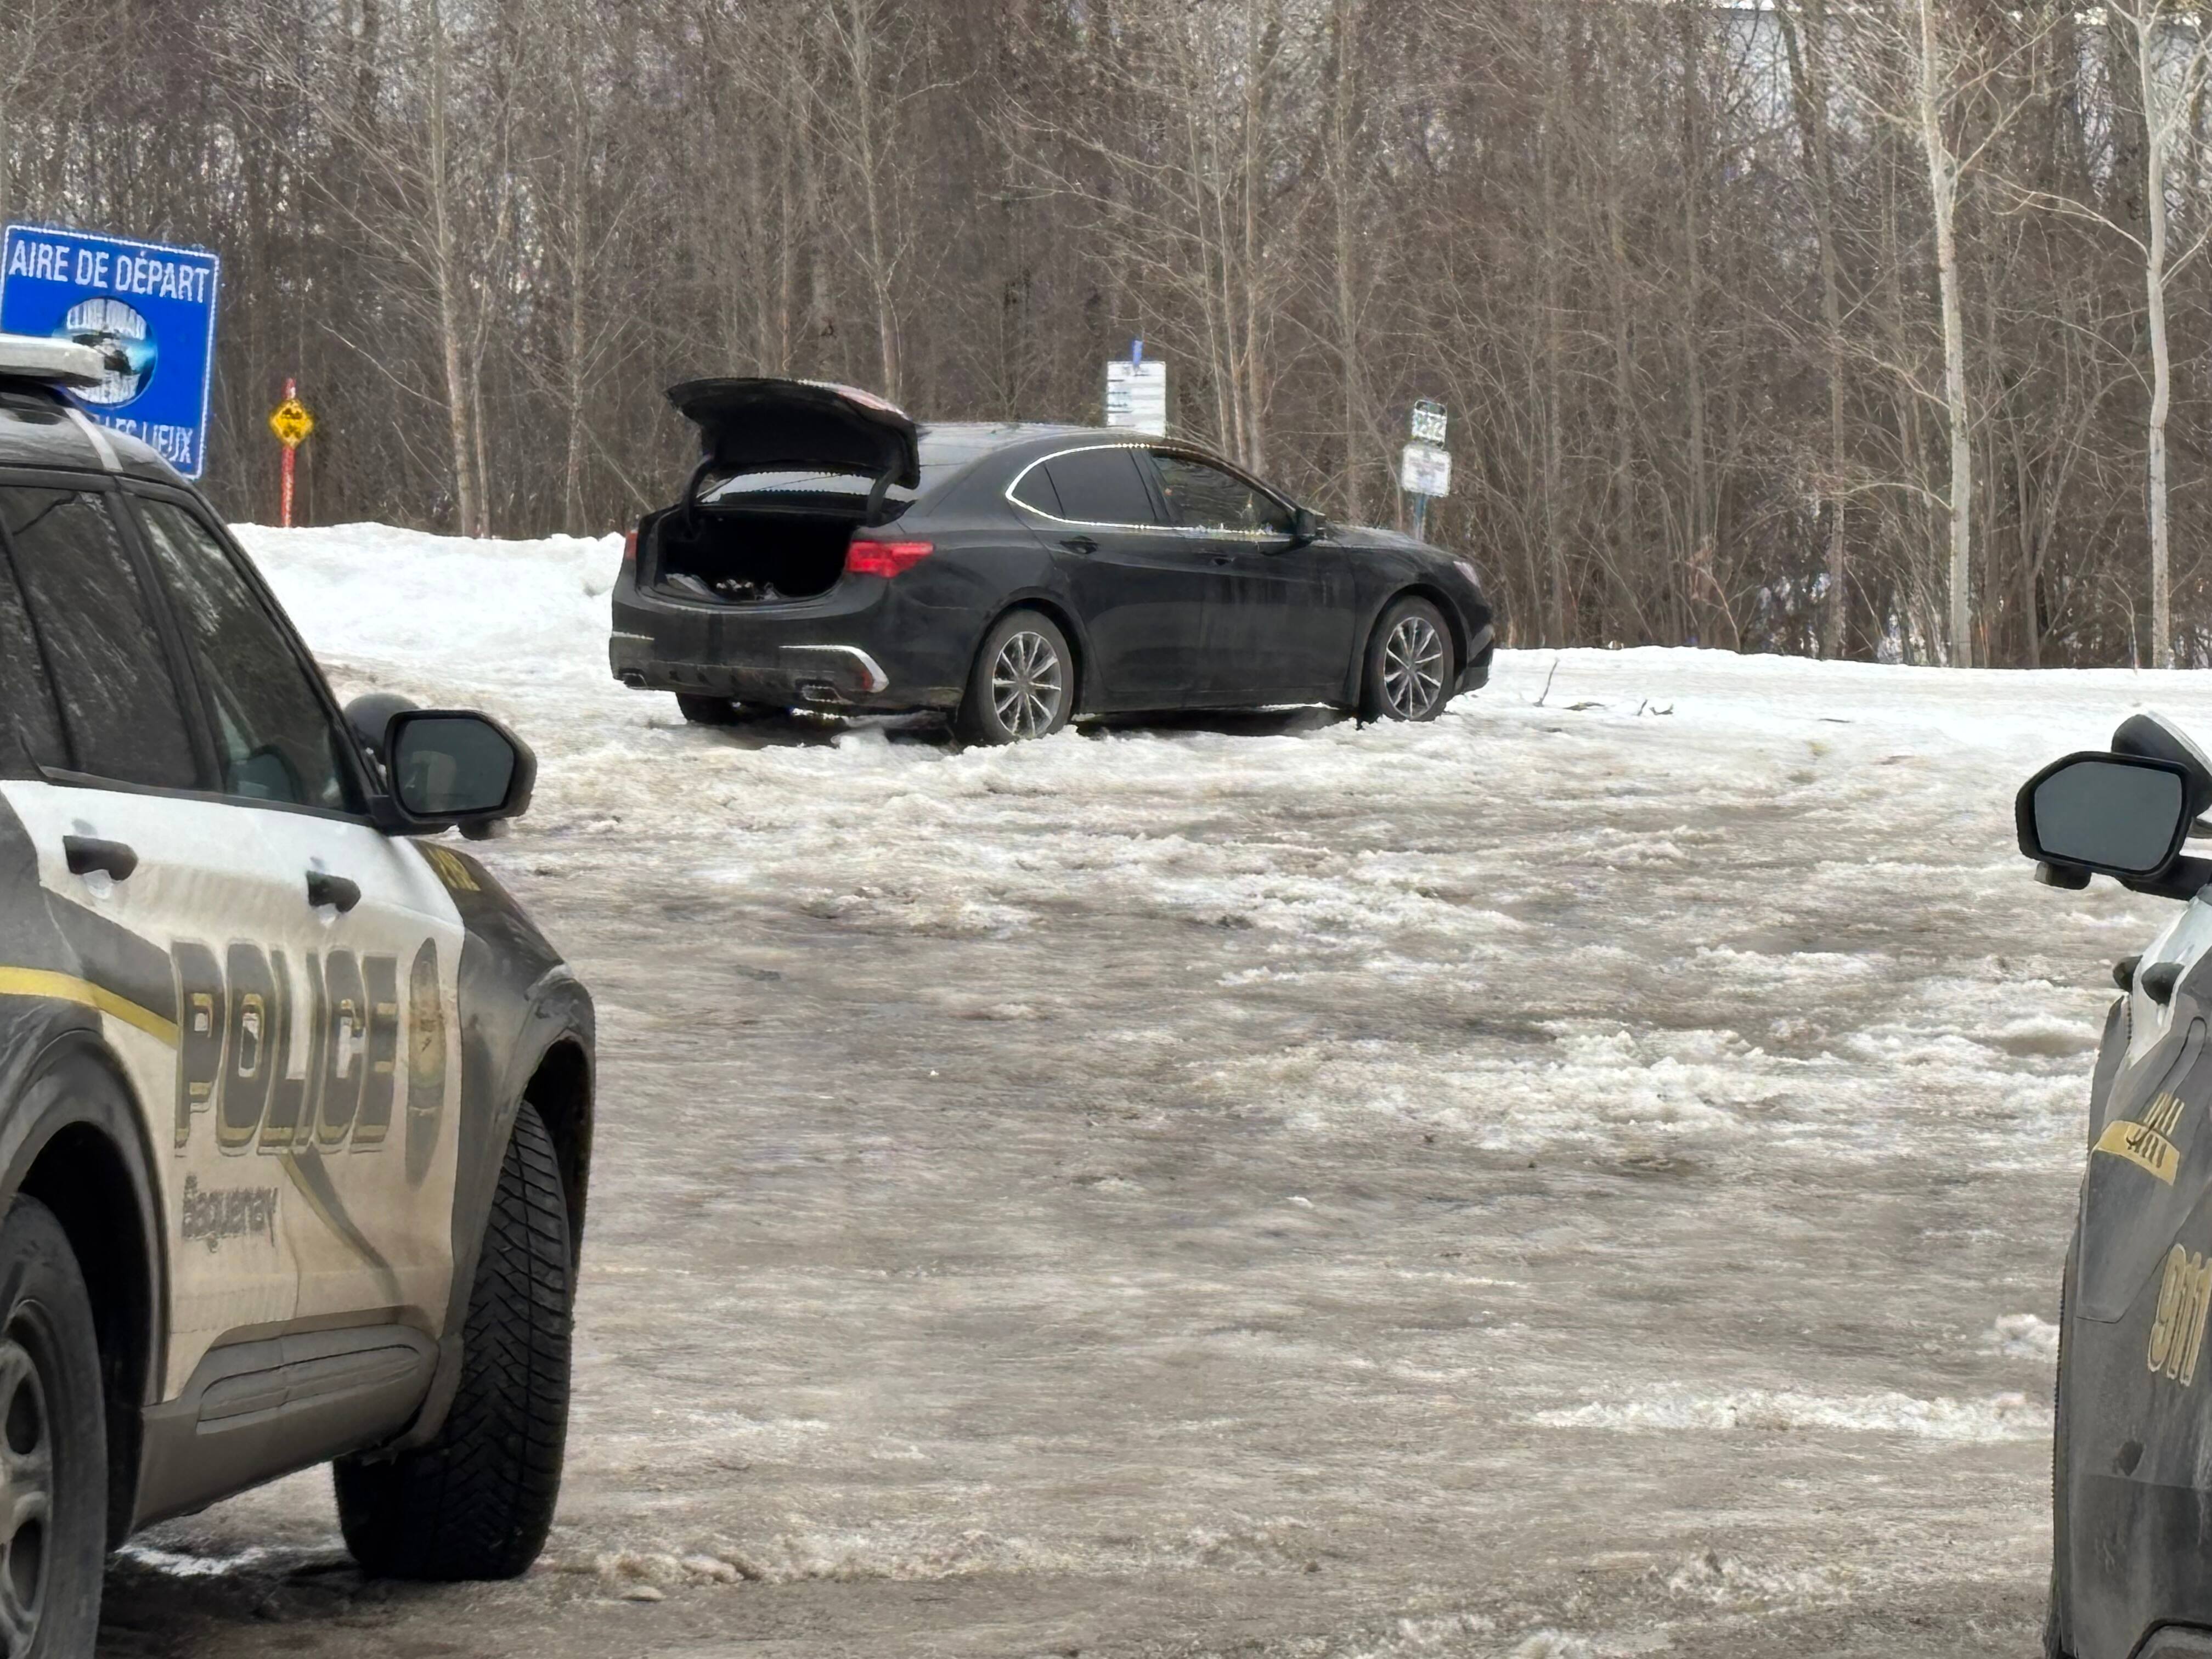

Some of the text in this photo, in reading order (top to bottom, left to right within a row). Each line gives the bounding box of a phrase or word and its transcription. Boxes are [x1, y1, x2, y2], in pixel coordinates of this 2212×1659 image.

[8, 240, 210, 303] AIRE DE DÉPART
[172, 939, 398, 1152] POLICE
